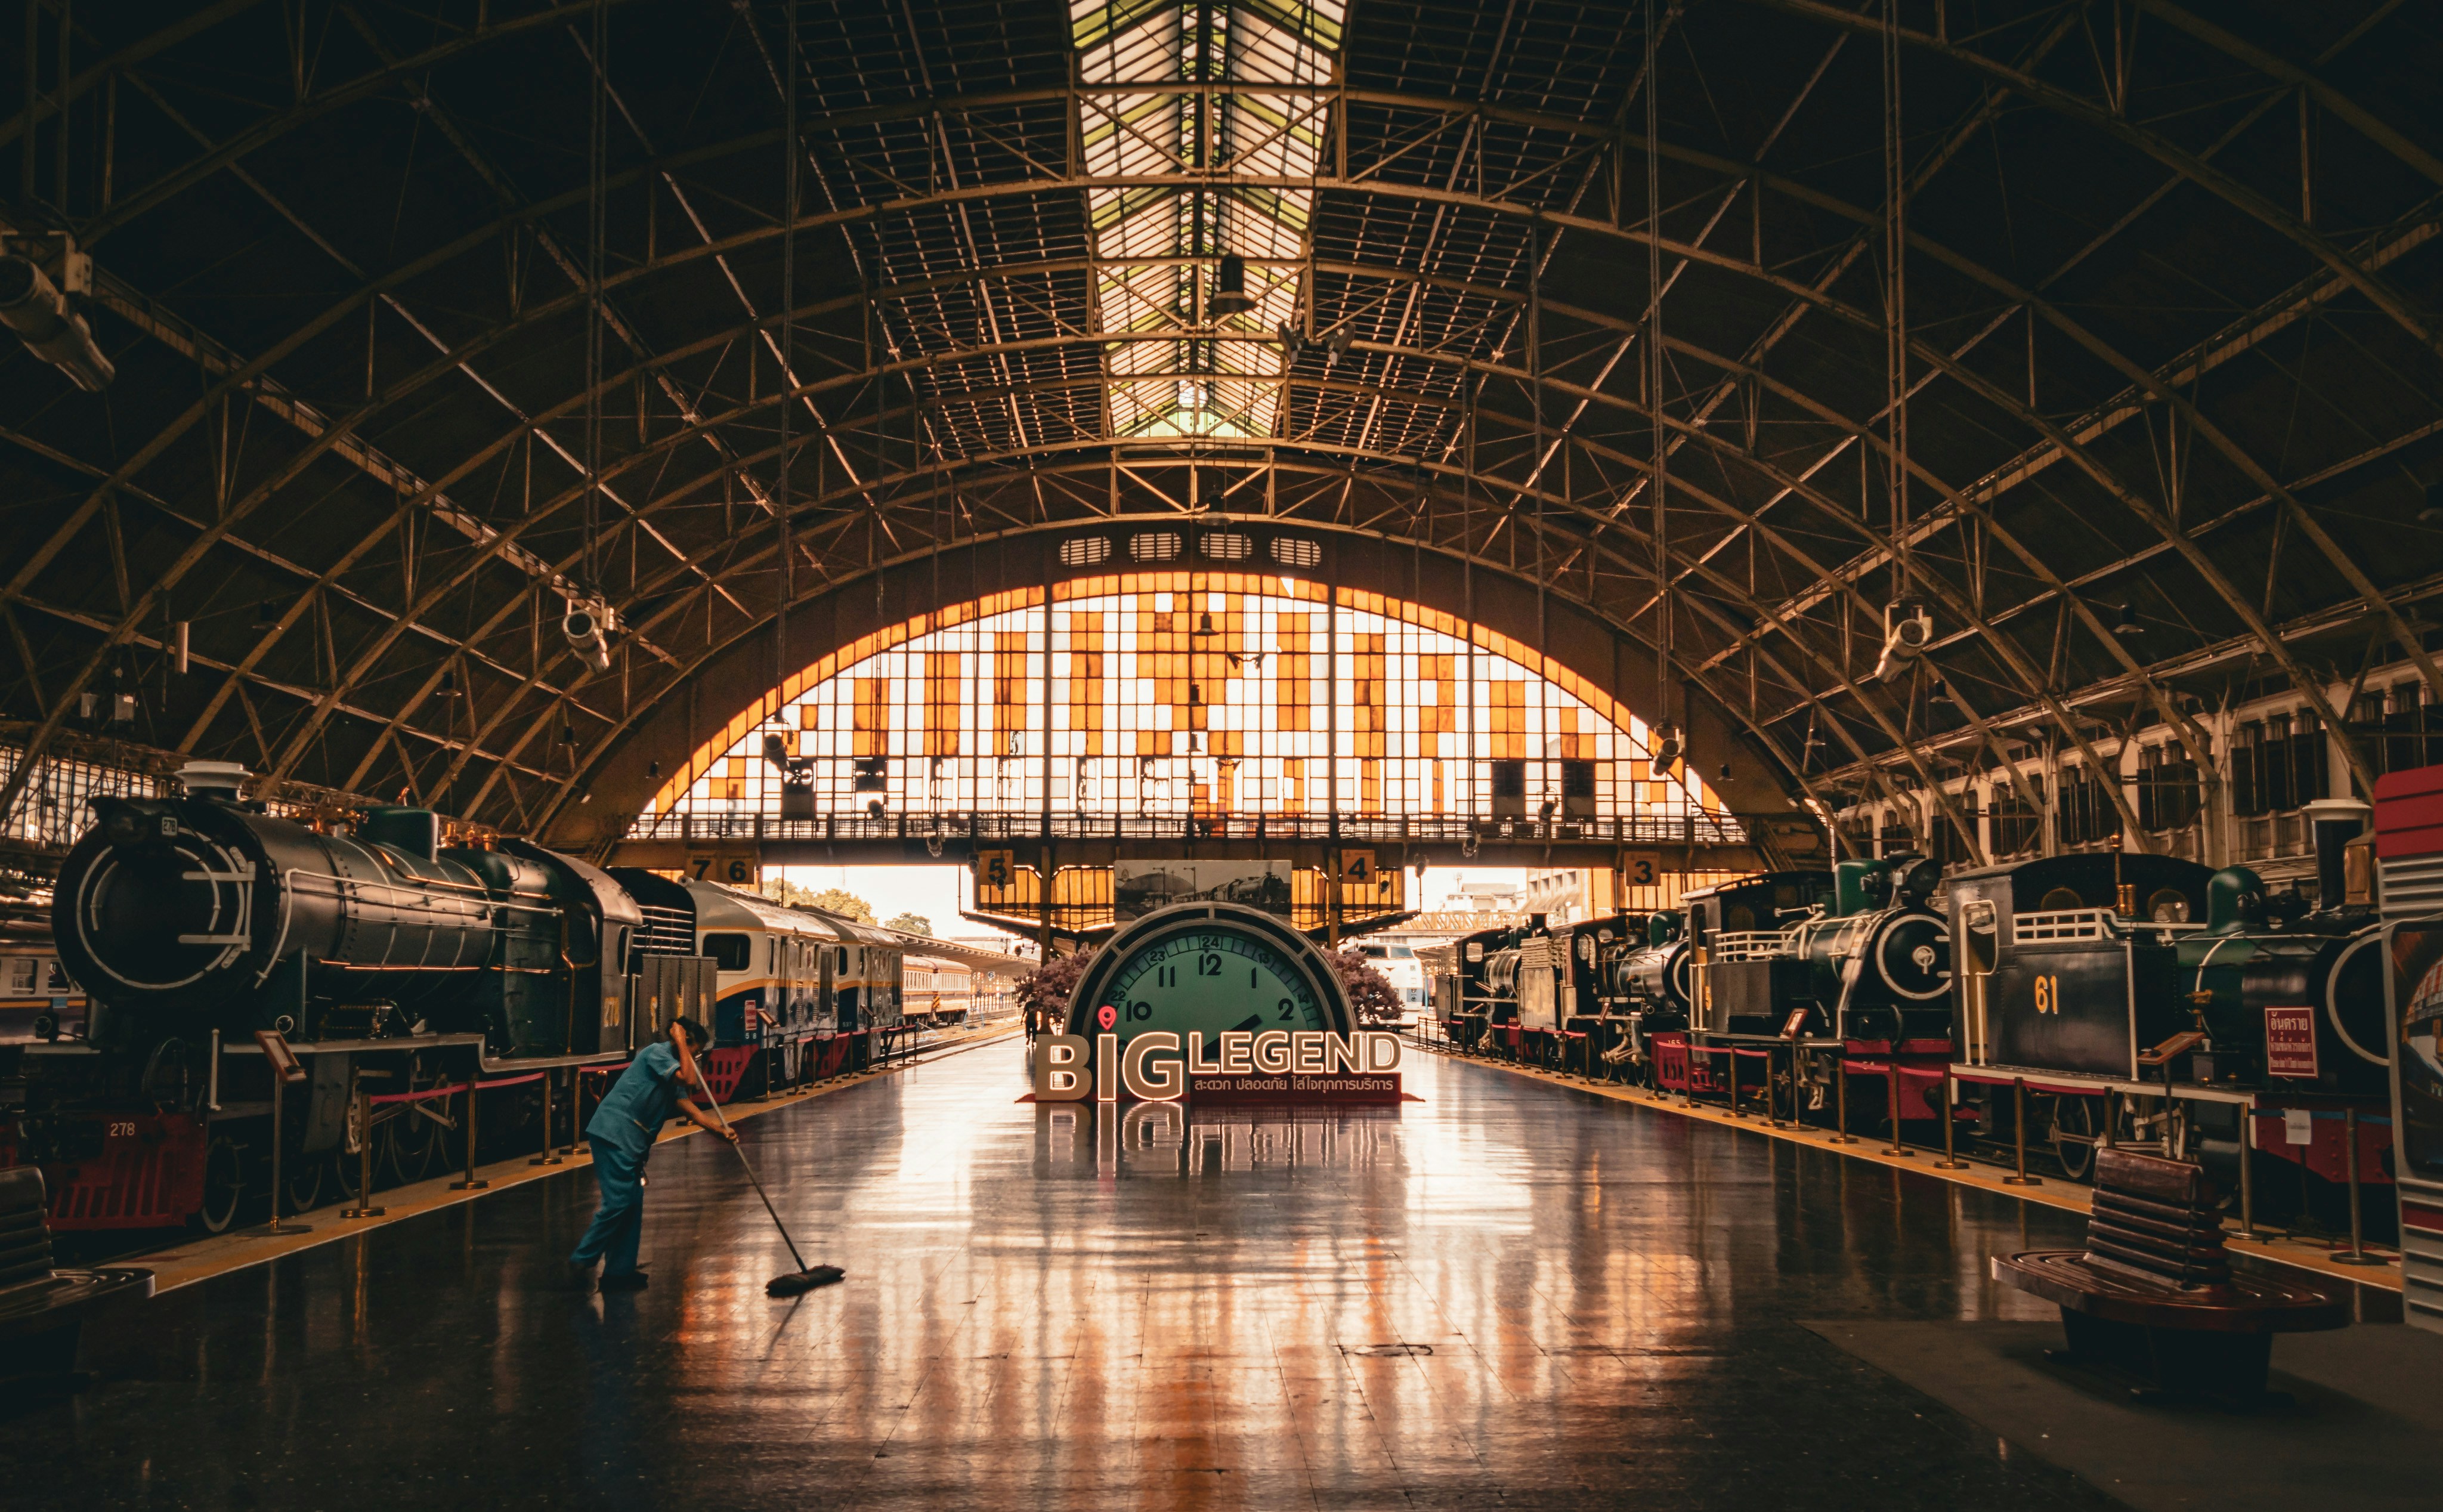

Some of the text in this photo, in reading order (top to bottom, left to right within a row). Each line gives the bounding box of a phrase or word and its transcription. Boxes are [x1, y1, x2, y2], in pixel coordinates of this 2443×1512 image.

[692, 859, 711, 881] 7
[729, 861, 747, 882] 6
[988, 858, 1007, 882] 5
[1349, 858, 1368, 880] 4
[1635, 861, 1653, 884] 3
[1202, 936, 1219, 947] 24
[1150, 951, 1165, 961] 23
[1199, 954, 1222, 976] 12
[1159, 966, 1175, 987] 11
[1251, 967, 1257, 988] 1
[1111, 991, 1126, 1001] 22
[2034, 975, 2058, 1014] 61
[1127, 1000, 1152, 1022] 10
[1278, 998, 1294, 1021] 2
[2270, 1011, 2308, 1031] อันตราย
[1035, 1031, 1402, 1101] BIG LEGEND
[1195, 1080, 1231, 1090] สะดวก
[1236, 1077, 1288, 1090] ปลอดภัย
[110, 1122, 135, 1136] 278
